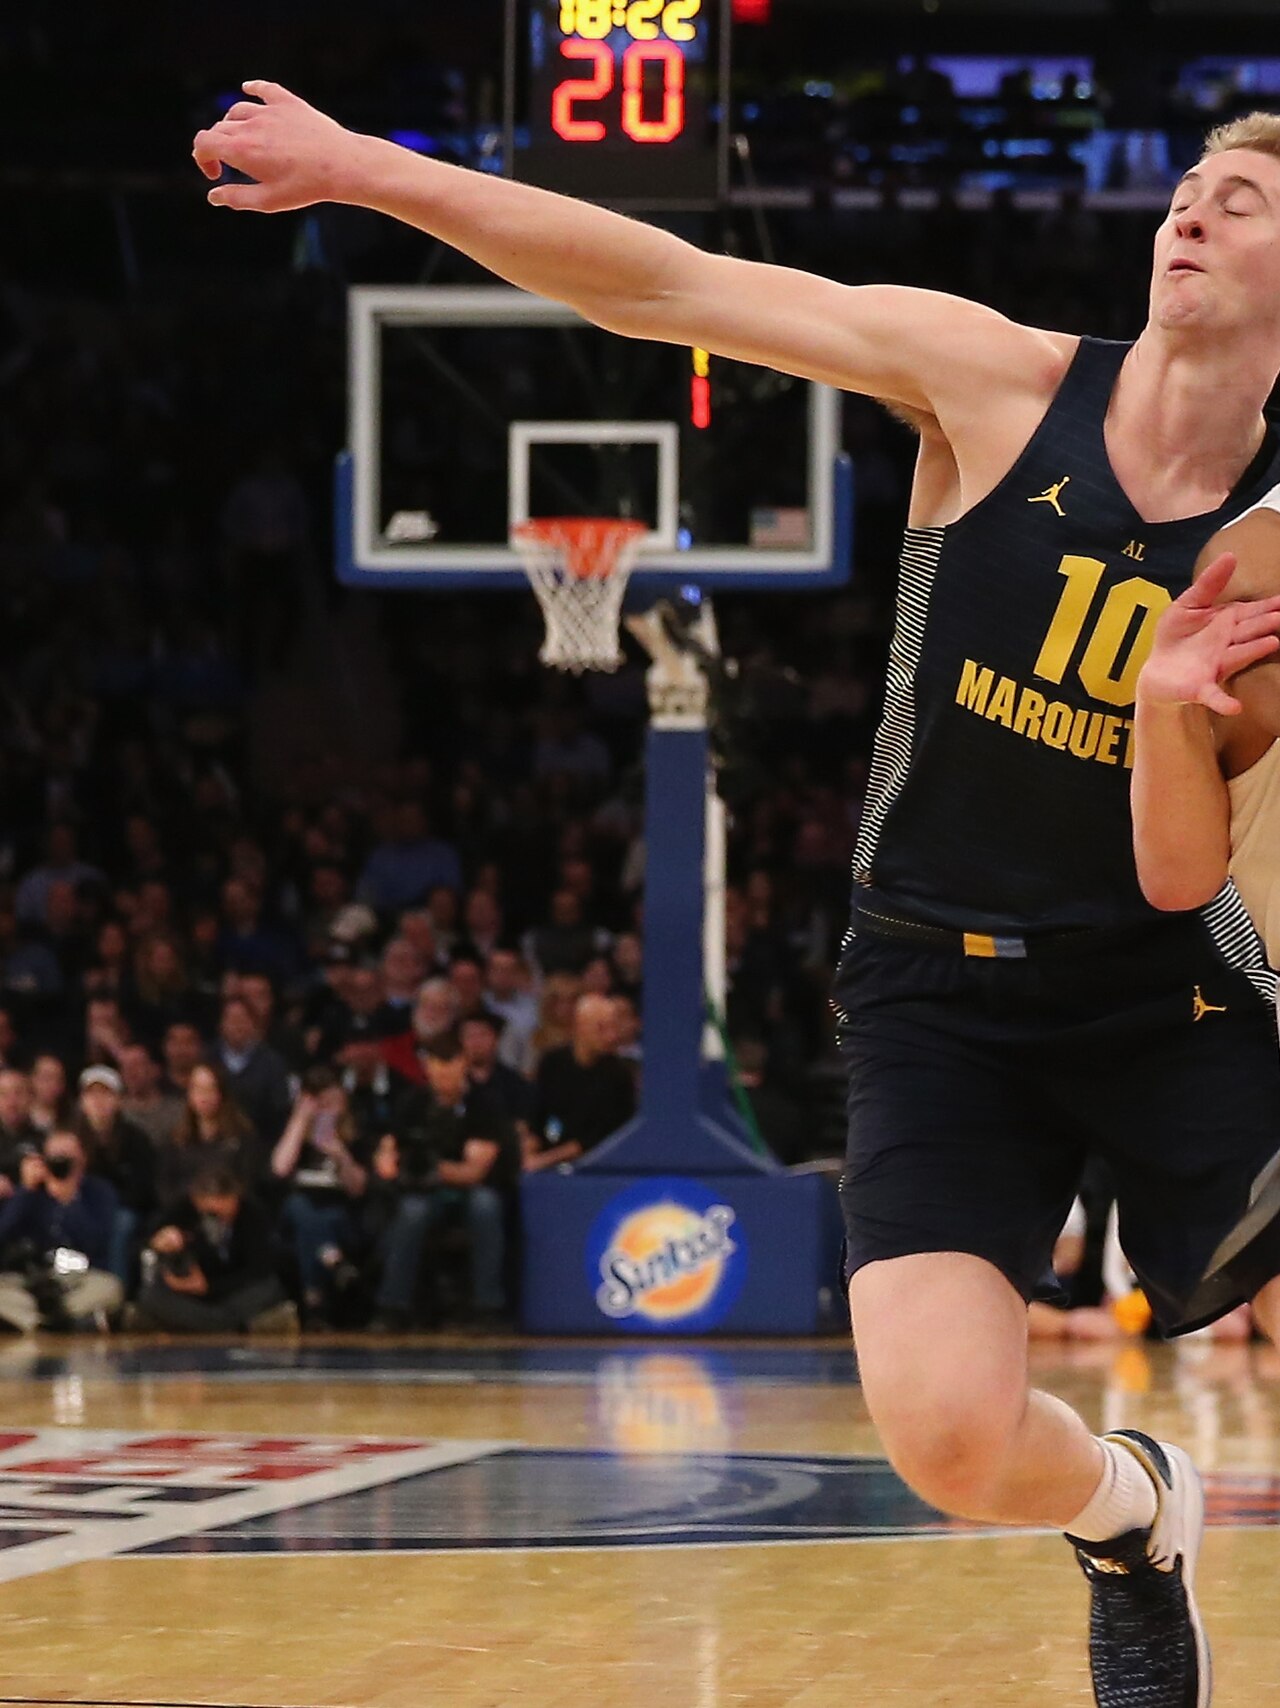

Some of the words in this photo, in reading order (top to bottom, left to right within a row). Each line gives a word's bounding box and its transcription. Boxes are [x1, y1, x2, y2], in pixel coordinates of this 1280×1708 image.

[552, 39, 684, 143] 20
[1120, 540, 1146, 562] AL
[1033, 554, 1173, 707] 10
[955, 658, 1136, 769] MARQUET
